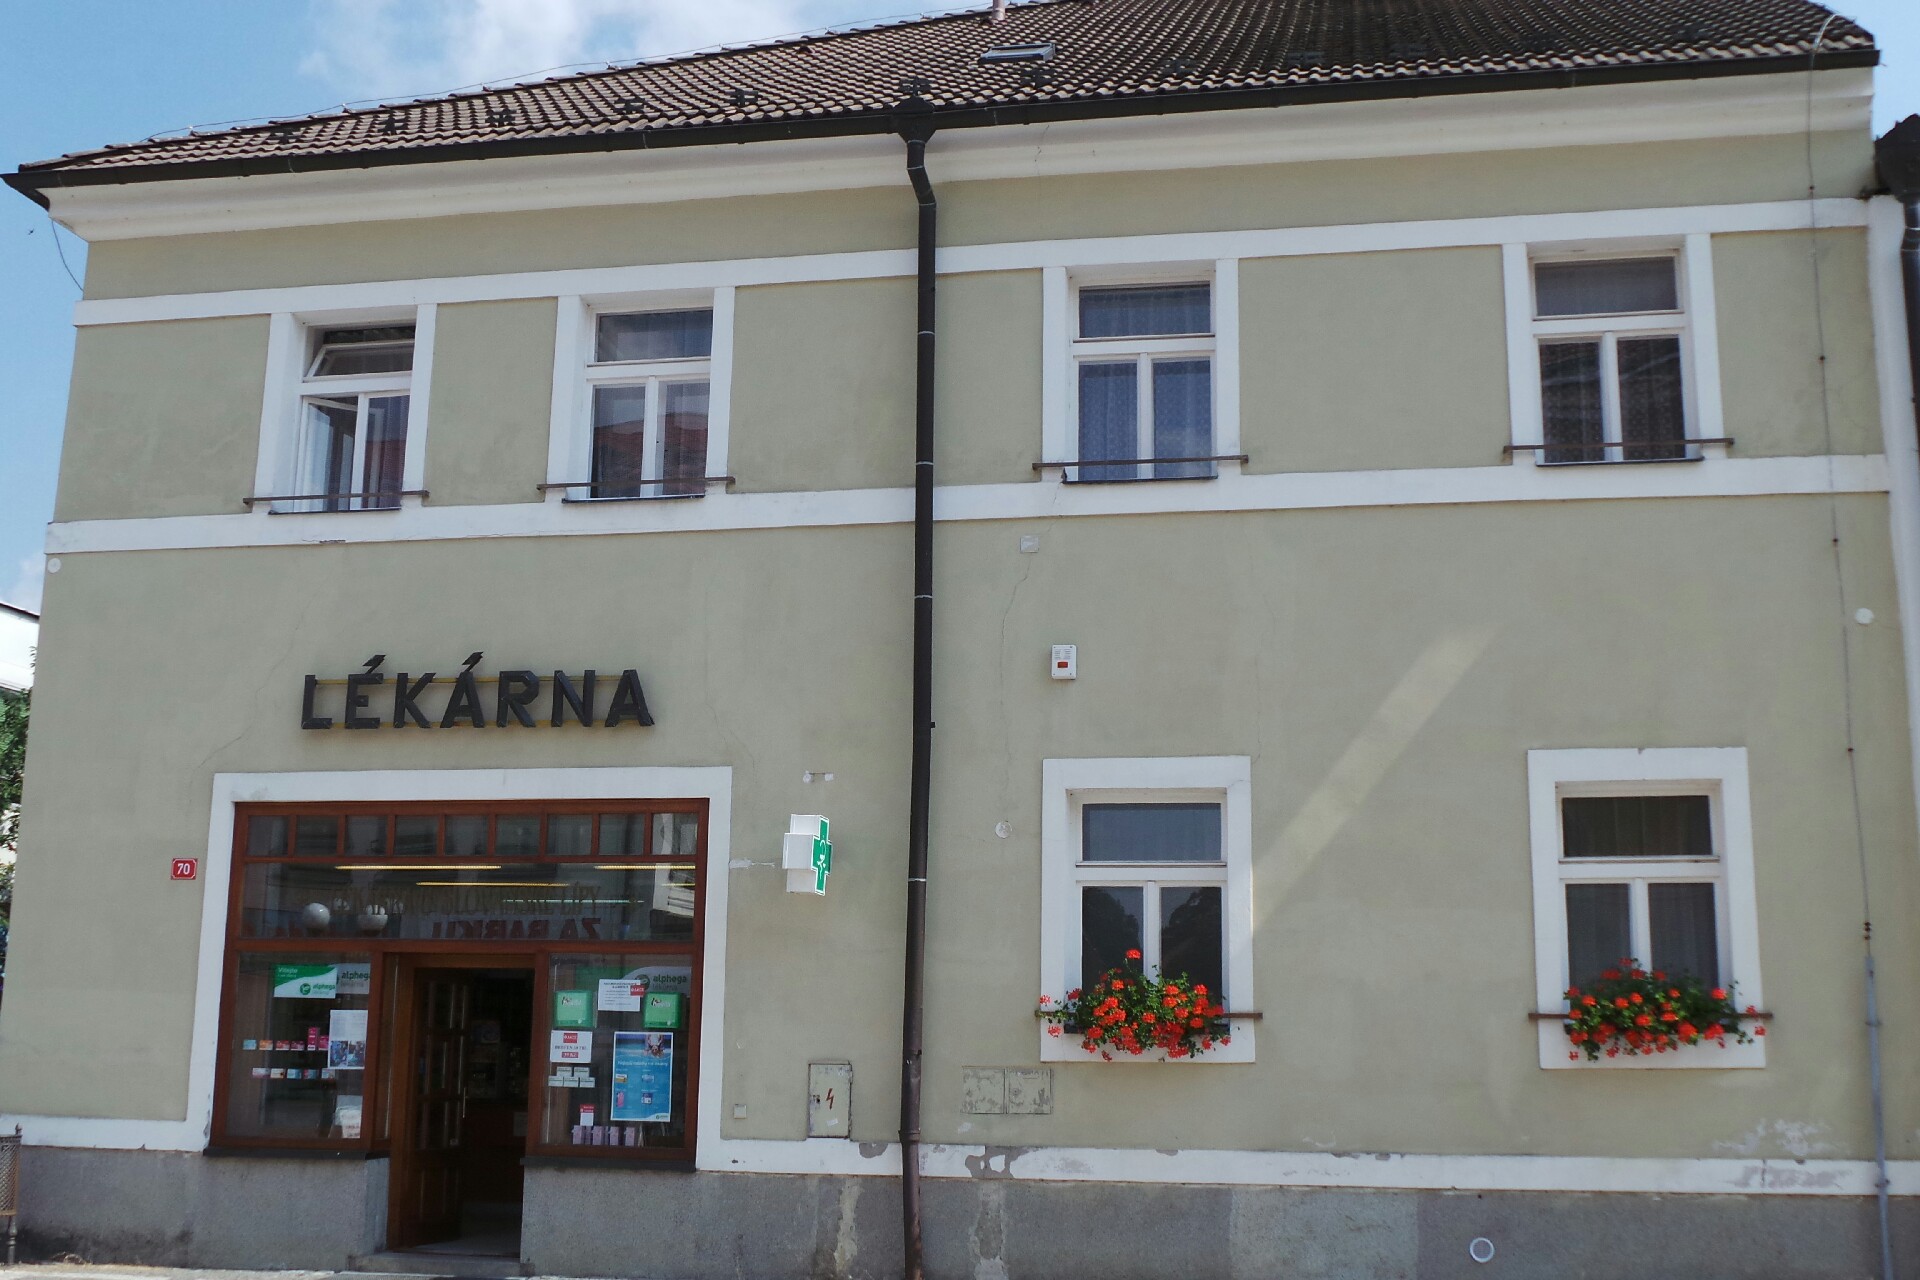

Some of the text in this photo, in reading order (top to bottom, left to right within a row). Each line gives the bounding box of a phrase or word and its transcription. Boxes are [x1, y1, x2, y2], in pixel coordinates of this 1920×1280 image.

[301, 651, 655, 730] LÉKÁRNA
[177, 863, 191, 875] 70
[653, 974, 687, 984] alphega
